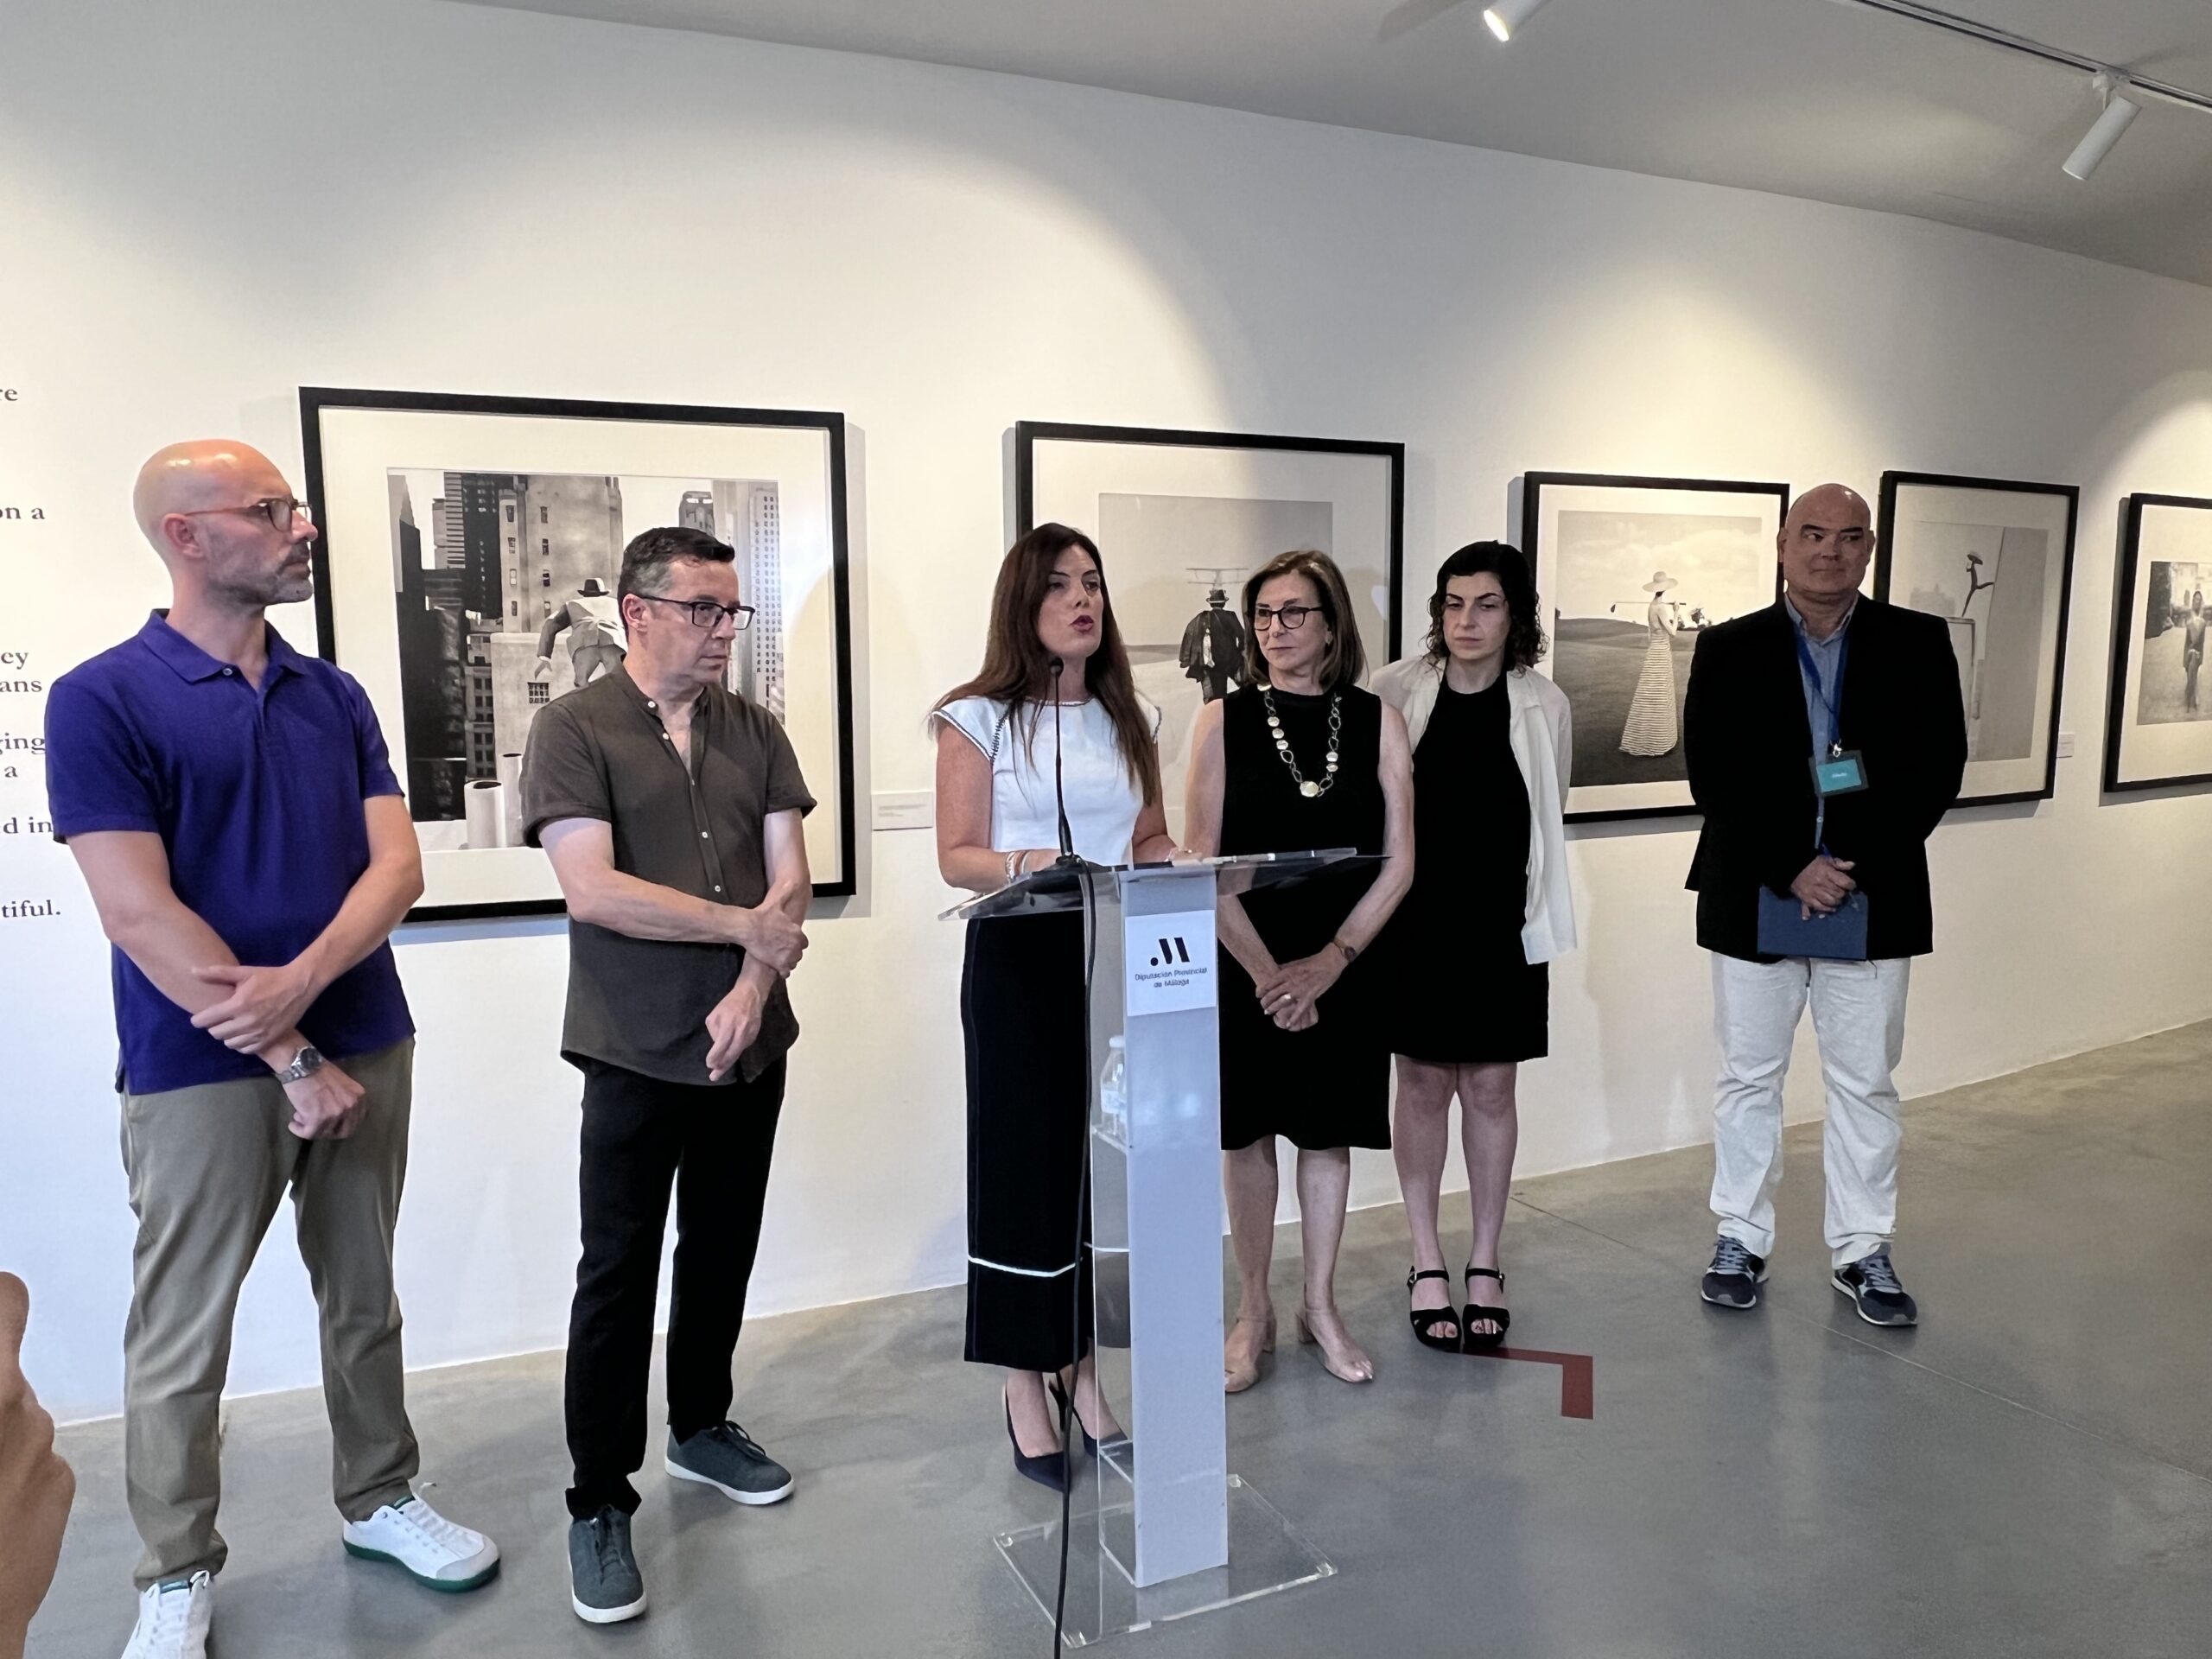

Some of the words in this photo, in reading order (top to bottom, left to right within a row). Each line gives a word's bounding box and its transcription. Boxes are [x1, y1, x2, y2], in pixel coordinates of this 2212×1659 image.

[30, 507, 46, 520] a
[0, 732, 46, 755] ing
[3, 766, 18, 779] a
[28, 817, 53, 834] in
[1, 899, 61, 918] tiful.
